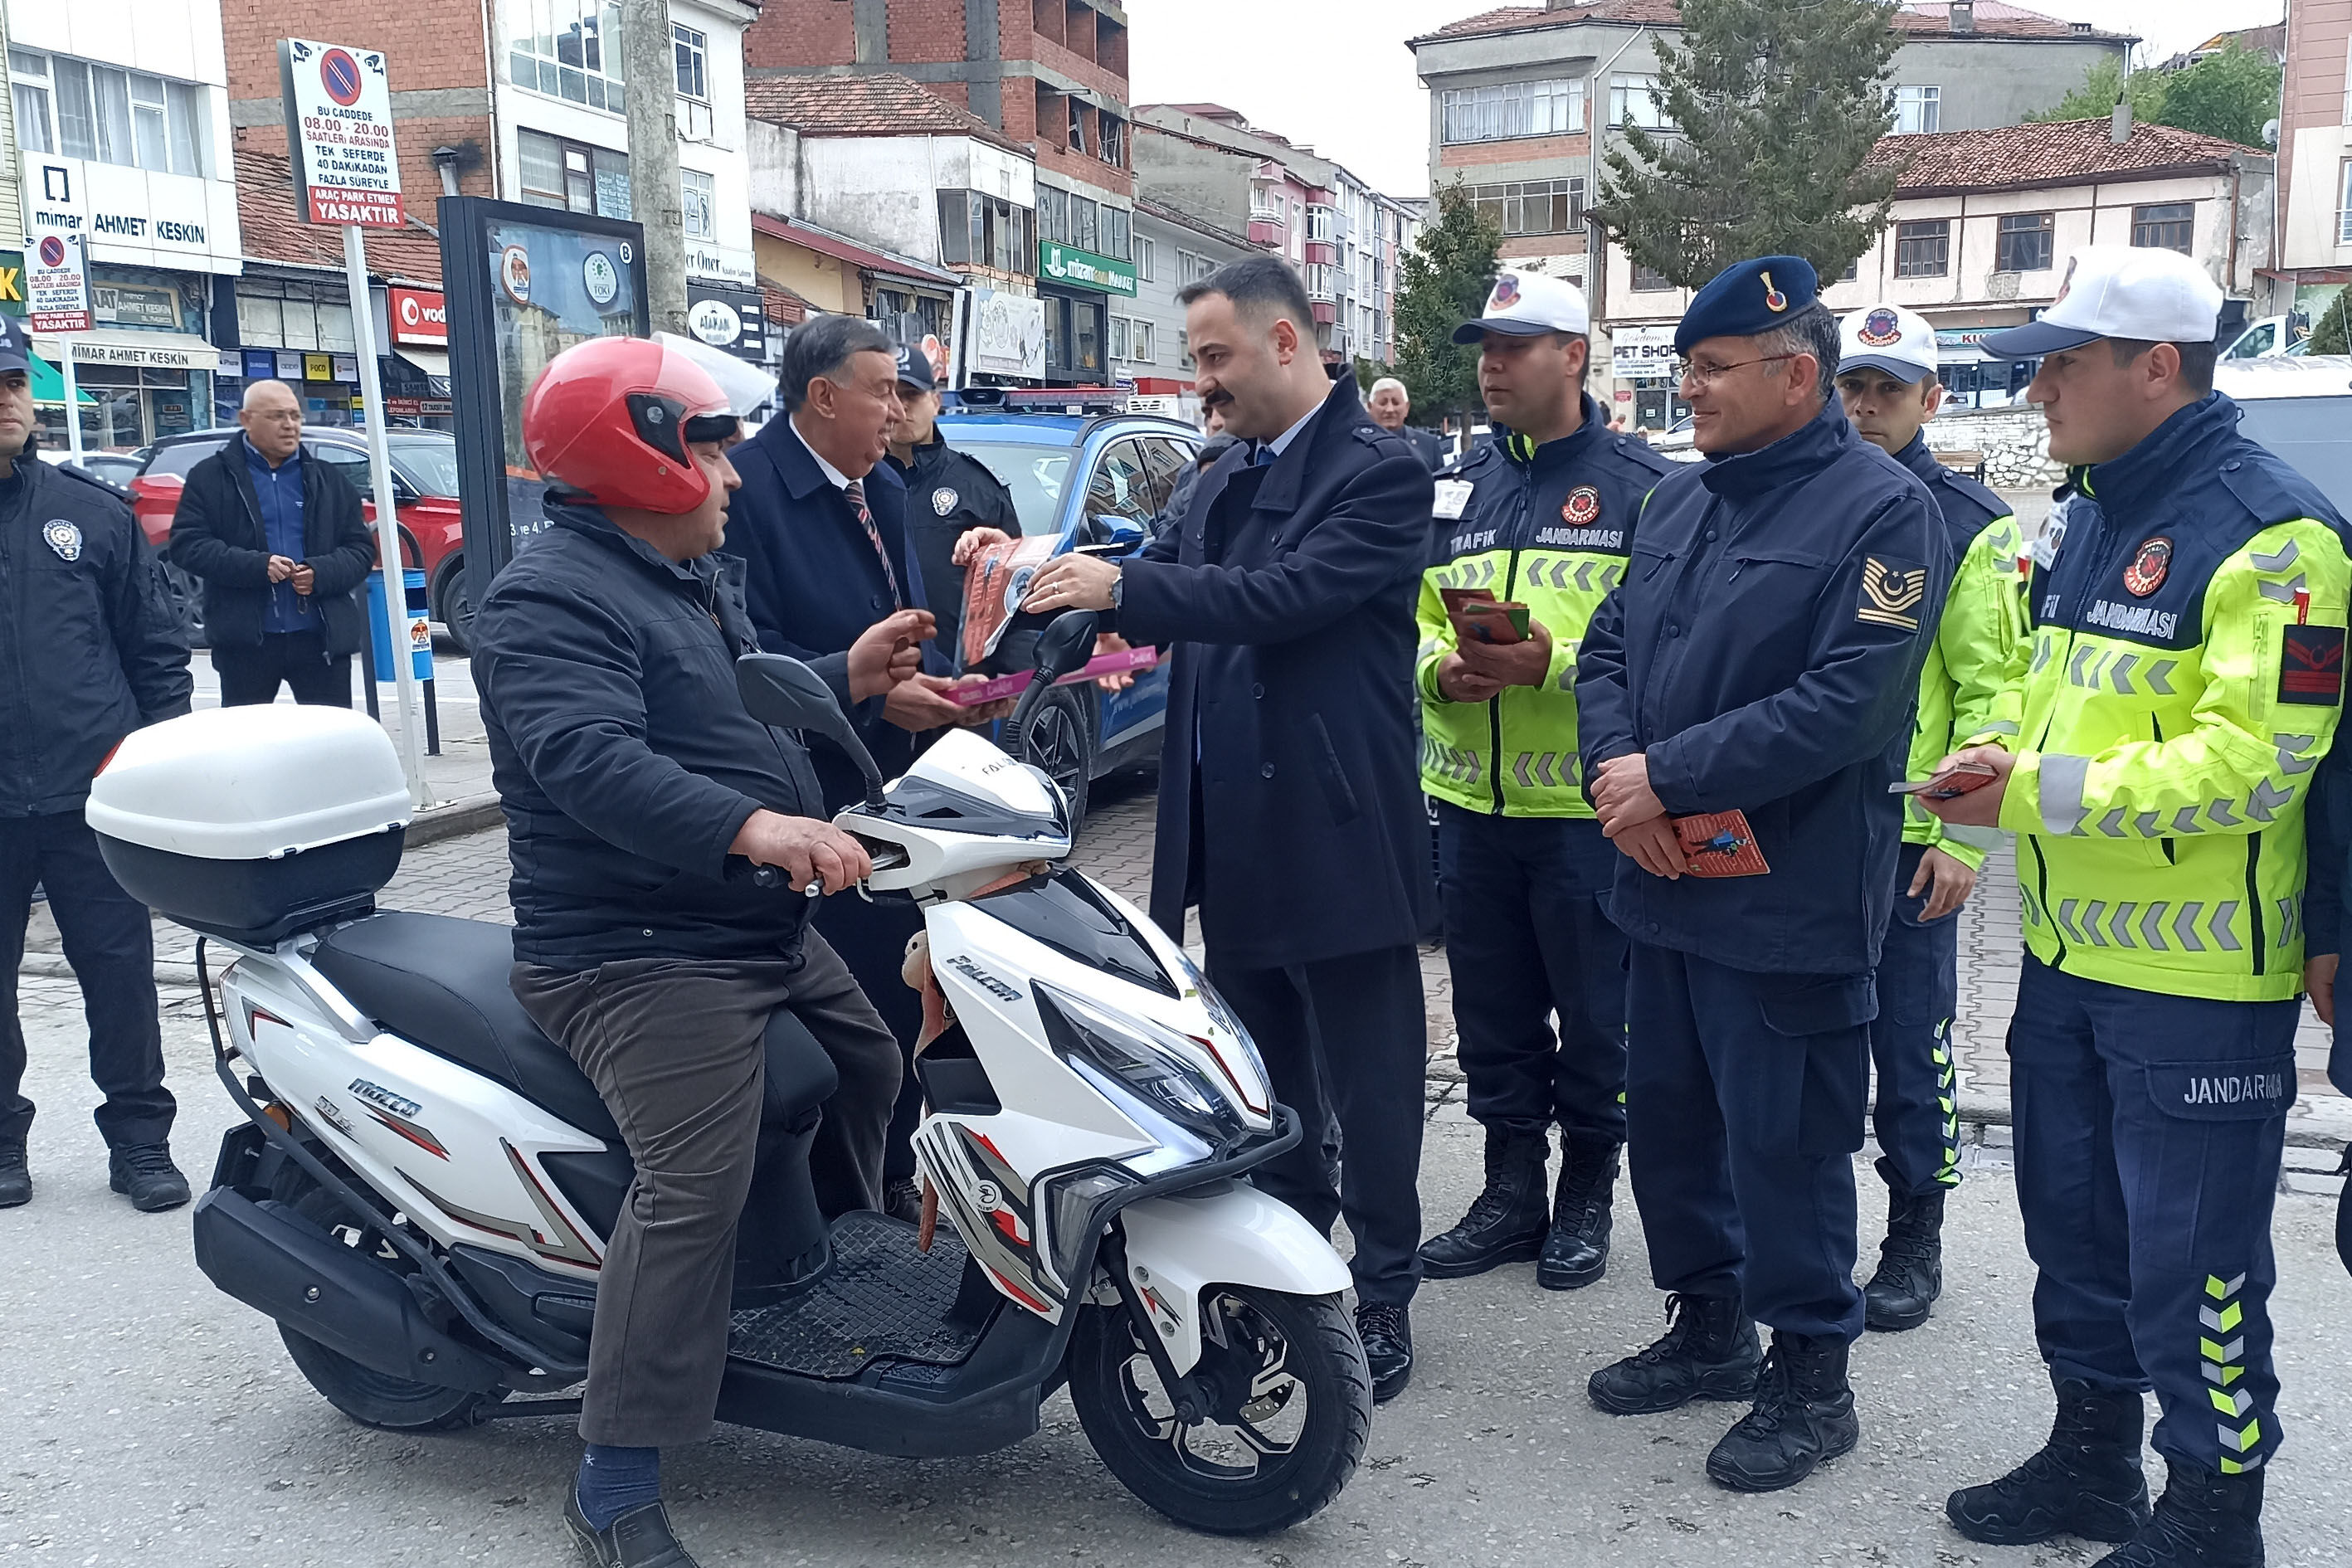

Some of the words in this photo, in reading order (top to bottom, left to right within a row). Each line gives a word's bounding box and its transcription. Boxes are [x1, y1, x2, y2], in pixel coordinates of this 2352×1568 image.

[317, 105, 330, 116] BU
[332, 108, 373, 122] CADDEDE
[304, 116, 341, 132] 08.00
[353, 122, 389, 138] 20.00
[315, 145, 334, 156] TEK
[342, 148, 386, 163] SEFERDE
[317, 158, 329, 169] 40
[319, 173, 347, 186] FAZLA
[348, 174, 389, 190] SÜREYLE
[315, 188, 340, 203] ARAÇ
[341, 190, 366, 203] PARK
[367, 192, 397, 206] ETMEK
[316, 202, 399, 224] YASAKTIR
[36, 207, 83, 229] mimar
[94, 213, 148, 237] AHMET
[156, 220, 206, 245] KESKİN
[622, 245, 630, 261] B
[35, 319, 86, 330] YASAKTIR
[110, 348, 146, 363] AHMET
[149, 351, 189, 366] KESKİN
[1613, 345, 1639, 358] PET
[1535, 527, 1624, 549] JANDARMASI
